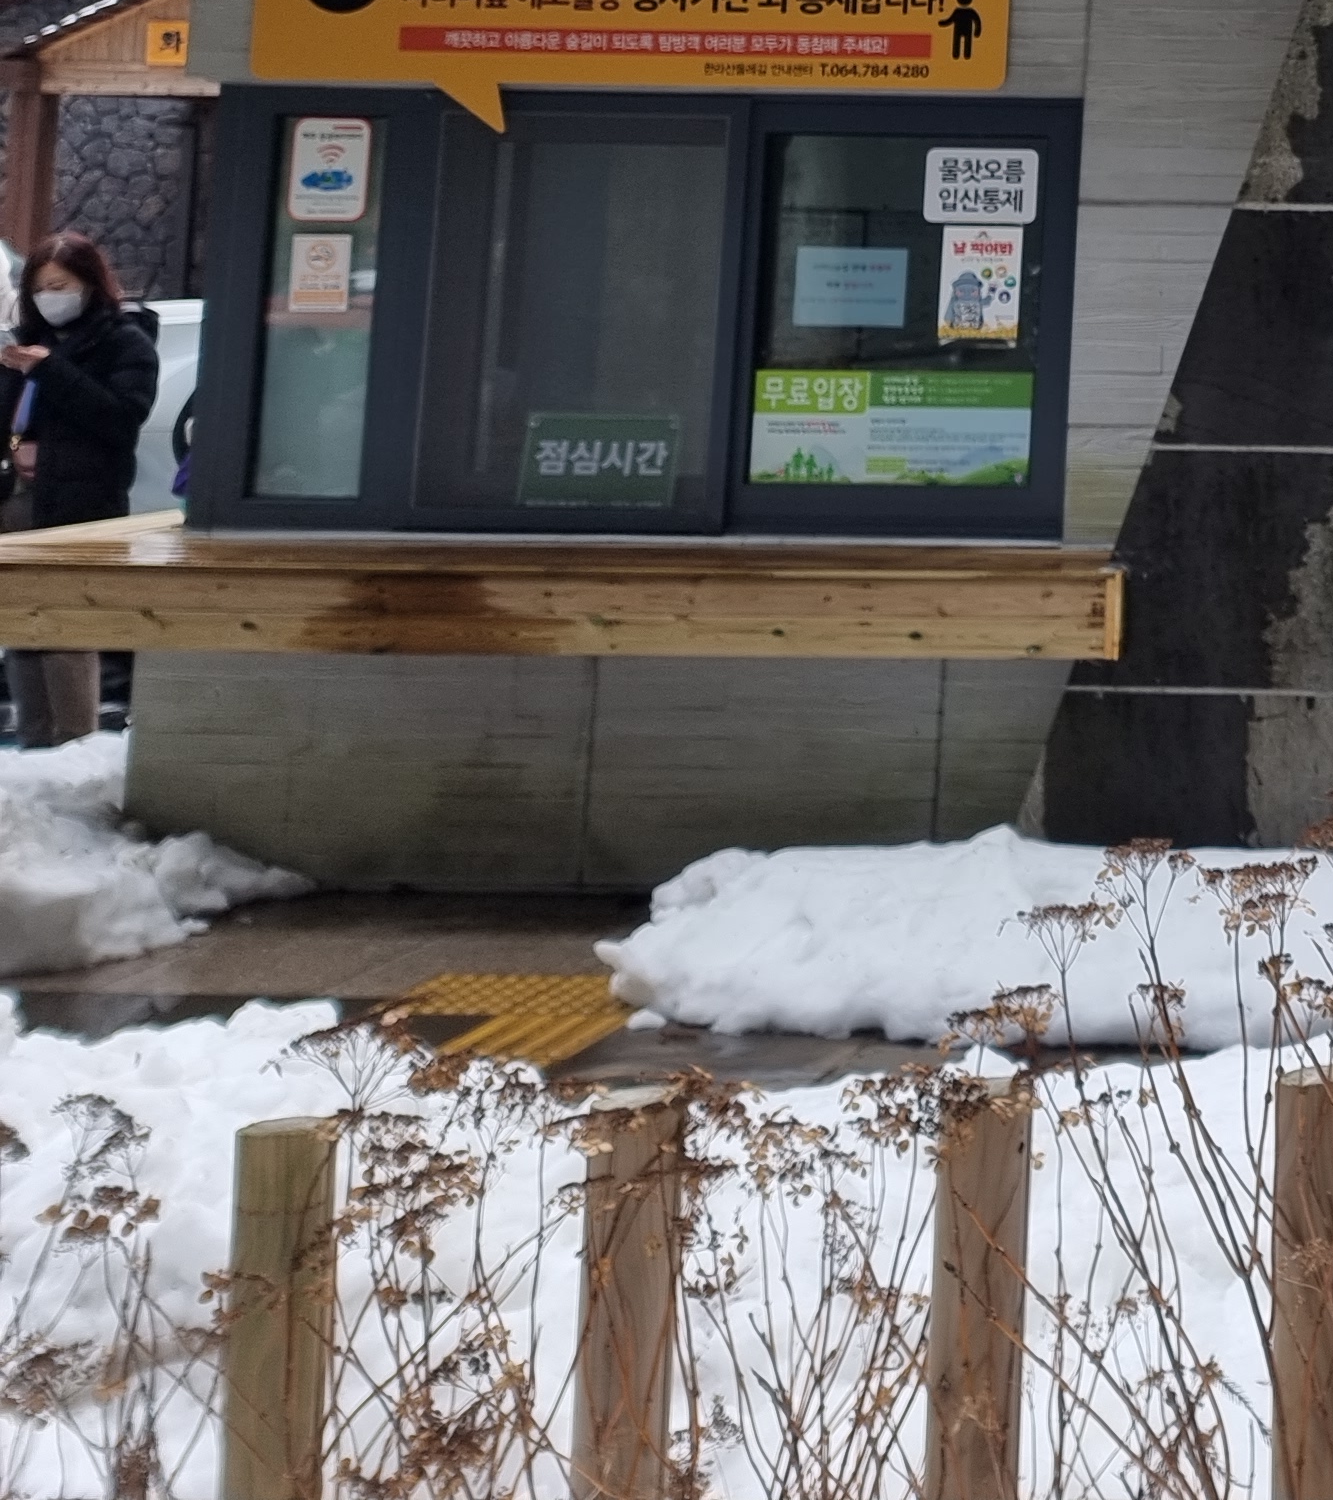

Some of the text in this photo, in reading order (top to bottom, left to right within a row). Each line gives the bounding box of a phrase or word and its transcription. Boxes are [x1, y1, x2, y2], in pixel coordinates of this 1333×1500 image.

[704, 34, 747, 53] 여러분
[938, 156, 1026, 184] 물찻오름
[938, 186, 1025, 214] 입산통제
[762, 375, 864, 412] 무료입장
[535, 439, 669, 477] 점심시간
